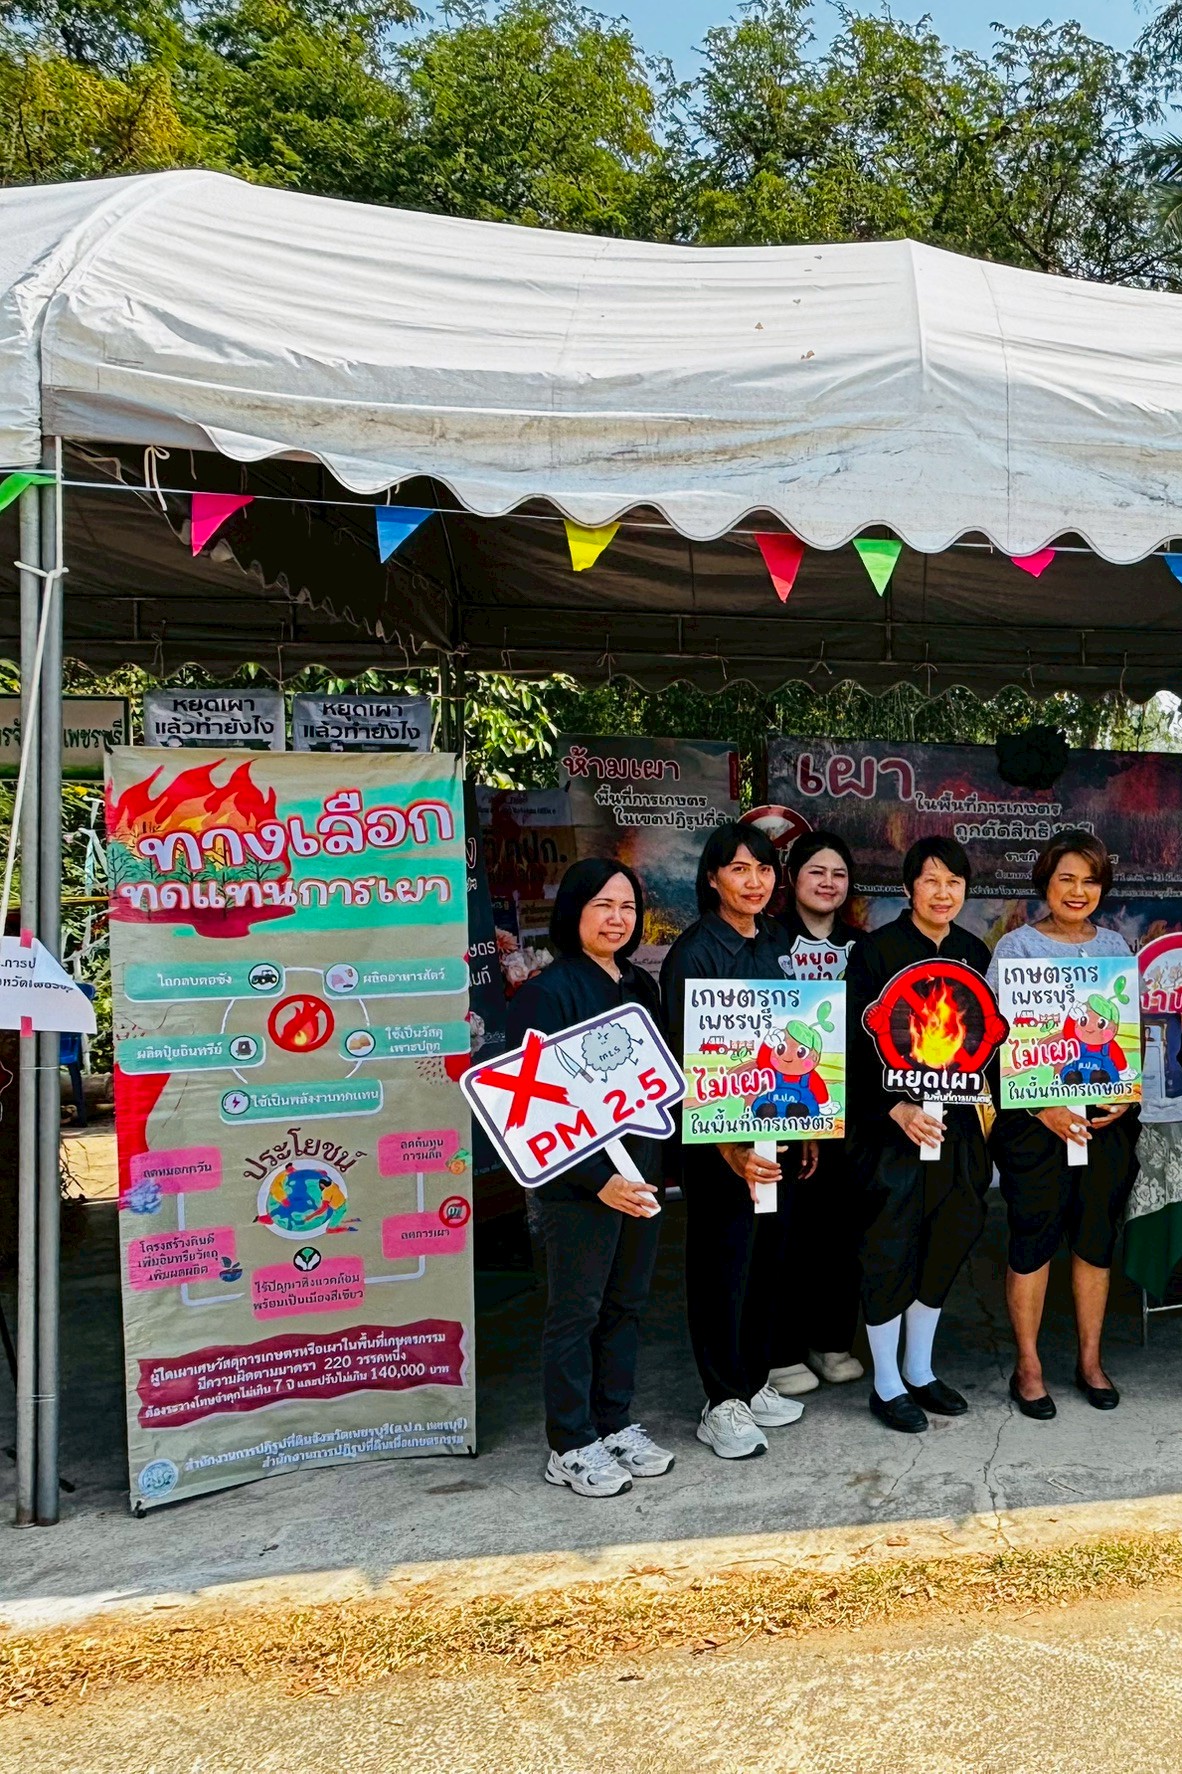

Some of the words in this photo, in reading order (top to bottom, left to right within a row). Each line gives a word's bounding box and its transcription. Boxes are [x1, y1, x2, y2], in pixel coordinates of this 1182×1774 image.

[155, 715, 275, 736] แล้วทำยังไง
[303, 720, 421, 739] แล้วทำยังไง
[562, 746, 680, 781] ห้ามเผา
[797, 753, 915, 800] เผา
[595, 784, 707, 808] พื้นที่การเกษตร
[915, 791, 1062, 816] ในพื้นที่การเกษตร
[138, 788, 454, 873] ทางเลือก
[118, 875, 451, 910] ทดแทนการเผา
[794, 950, 838, 973] หยุด
[1004, 966, 1099, 985] เกษตรกร
[691, 988, 800, 1008] เกษตรกร
[1012, 984, 1077, 1010] เพชรบุรี
[699, 1007, 773, 1038] เพชรบุรี
[1008, 1038, 1081, 1070] ไม่เผา
[692, 1066, 776, 1103] ไม่เผา
[887, 1069, 980, 1095] หยุดเผา
[1008, 1076, 1133, 1100] ในพื้นที่การเกษตร
[526, 1109, 598, 1168] PM
[603, 1067, 668, 1124] 2.5
[691, 1108, 834, 1135] ในพื้นที่การเกษตร
[243, 1127, 368, 1181] ประโยชน์
[198, 1361, 317, 1390] มีความผิดตามมาตรา
[324, 1355, 352, 1371] 220
[356, 1349, 407, 1366] วรรคหนึ่ง
[273, 1379, 283, 1393] 7
[286, 1380, 296, 1391] ปี
[371, 1363, 426, 1381] 140,000
[430, 1365, 450, 1376] บาท
